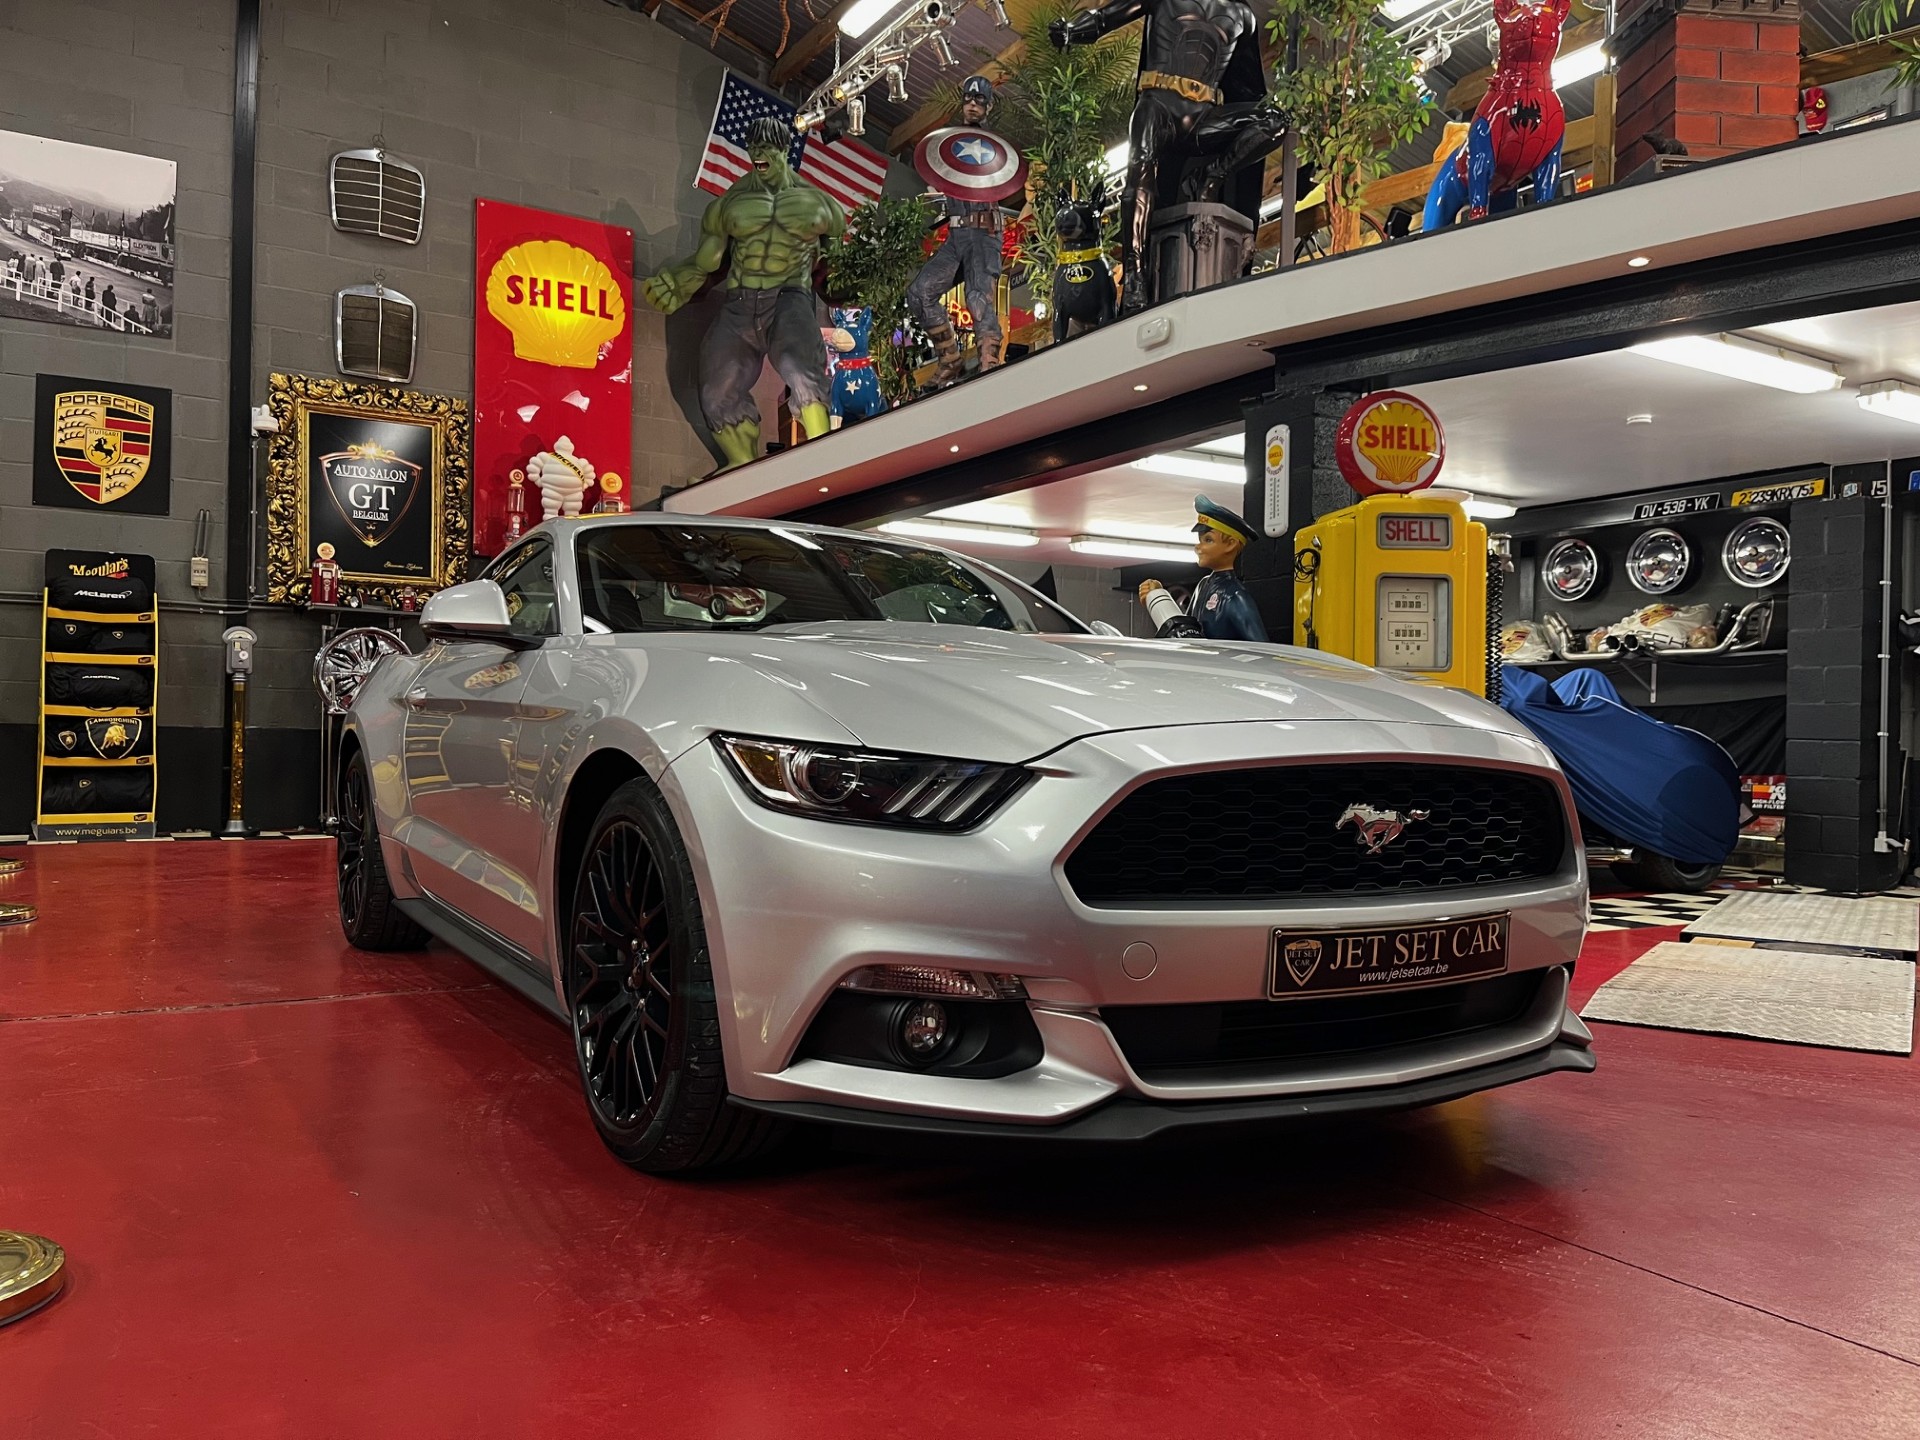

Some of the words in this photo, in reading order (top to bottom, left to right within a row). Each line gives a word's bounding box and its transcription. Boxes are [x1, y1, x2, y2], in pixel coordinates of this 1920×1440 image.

[506, 275, 614, 320] SHELL
[59, 395, 149, 417] PORSCHE
[89, 429, 119, 437] STUTTGART
[1364, 425, 1430, 452] SHELL
[334, 464, 367, 478] AUTO
[369, 467, 407, 481] SALON
[348, 483, 396, 511] GT
[352, 509, 389, 521] BELGIUM
[1385, 520, 1440, 542] SHELL
[74, 590, 126, 599] McLaren
[55, 827, 137, 837] www.meguiars.be
[1289, 950, 1301, 958] JET
[1303, 950, 1317, 958] SET
[1329, 935, 1386, 970] JET
[1394, 930, 1446, 965] SET
[1452, 922, 1502, 958] CAR
[1294, 959, 1310, 967] CAR
[1359, 963, 1449, 982] www.jetsetcar.be
